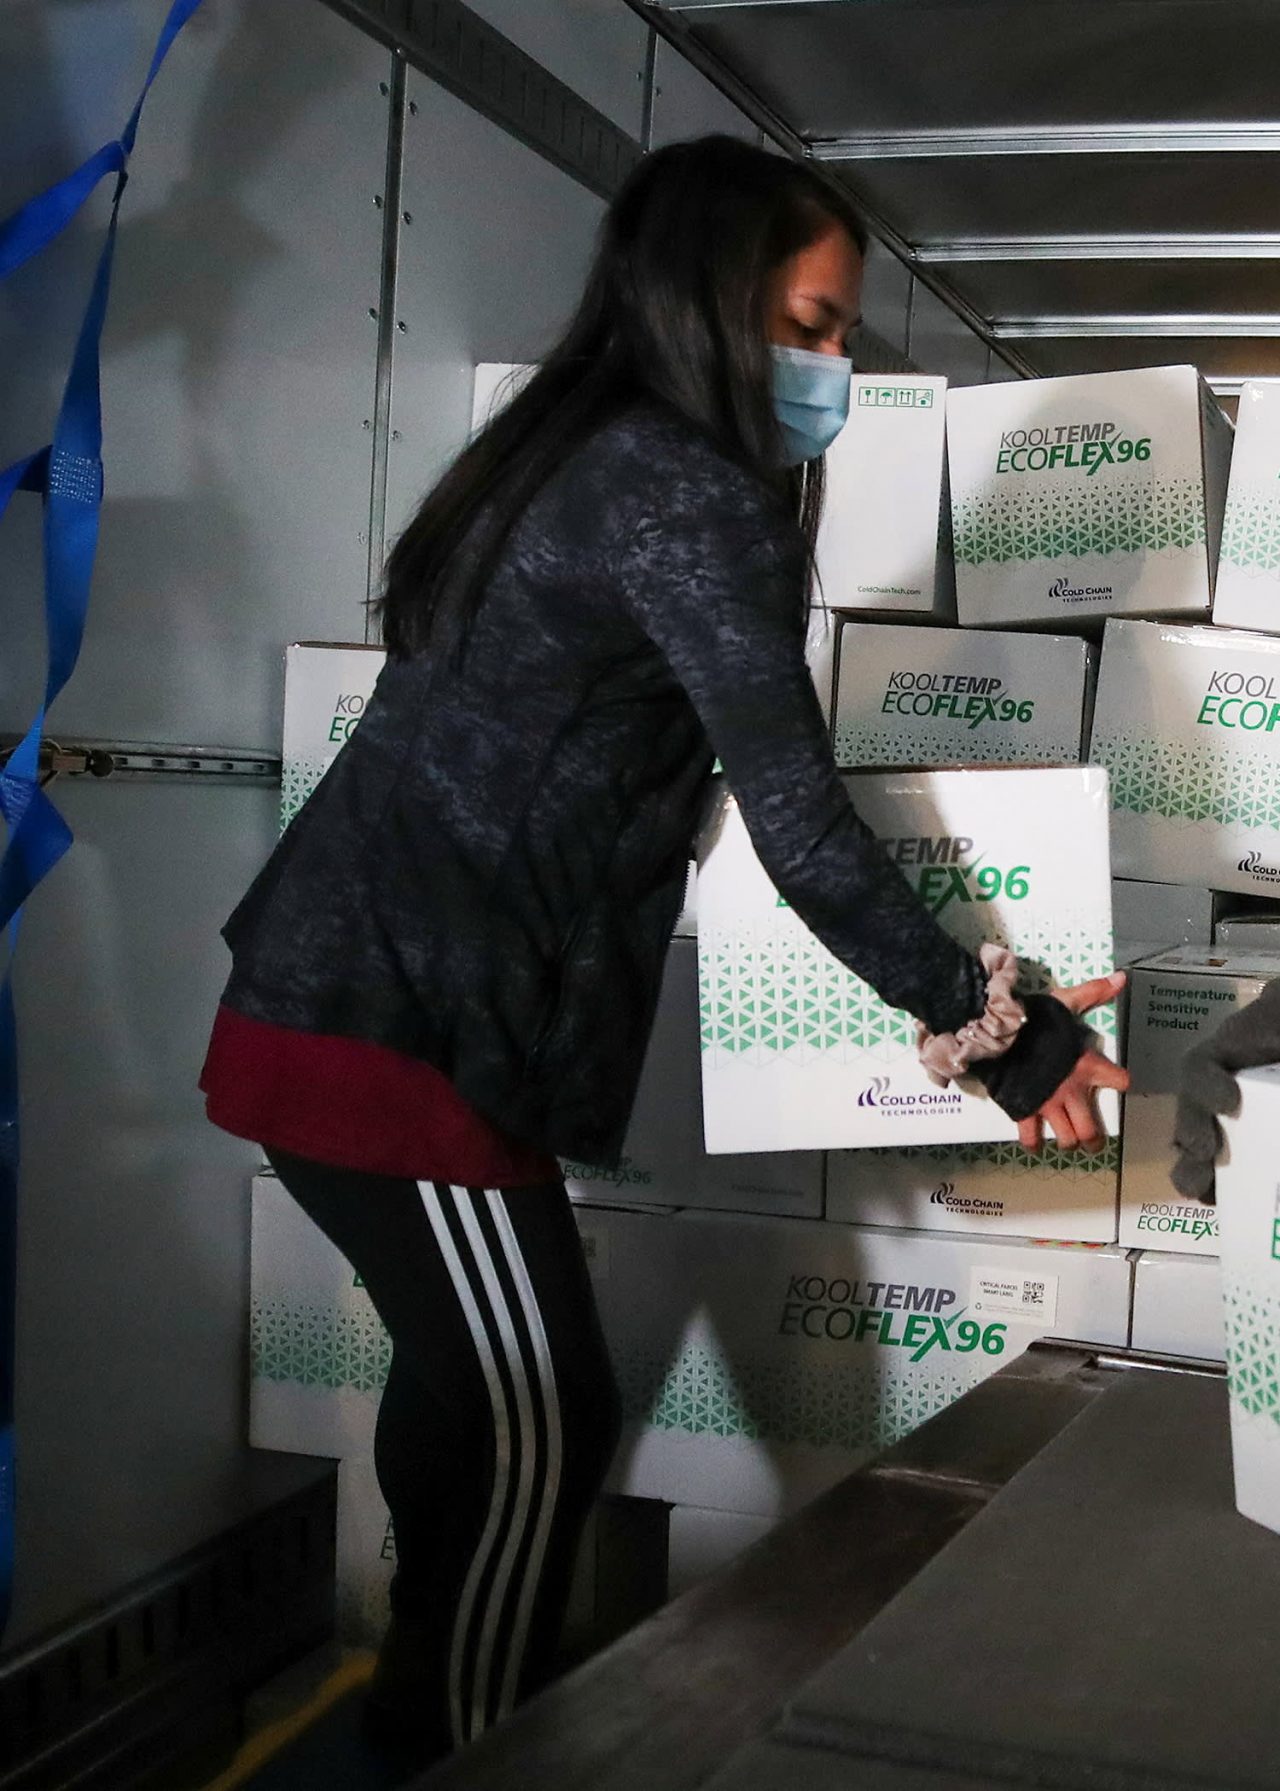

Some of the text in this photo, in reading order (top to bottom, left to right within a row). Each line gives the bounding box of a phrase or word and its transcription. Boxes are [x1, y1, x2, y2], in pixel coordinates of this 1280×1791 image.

[1000, 422, 1115, 449] KOOLTEMP
[996, 430, 1151, 476] ECOFLEX96
[1062, 587, 1083, 597] COLD
[887, 671, 1002, 694] KOOLTEMP
[881, 690, 1034, 729] ECOFLEX96
[1253, 865, 1277, 876] COLD
[1149, 984, 1236, 1003] Temperature
[1148, 1002, 1209, 1016] Sensitive
[1147, 1016, 1199, 1031] Product
[880, 1093, 962, 1106] COLD CHAIN
[881, 1107, 963, 1117] TECHNOLOGIES
[946, 1196, 1004, 1210] COLD CHAIN
[1141, 1203, 1215, 1219] KOOLTEMP
[946, 1207, 1004, 1217] TECHNOLOGIES
[1137, 1215, 1220, 1241] ECOFLEX
[786, 1274, 956, 1313] KOOLTEMP
[778, 1303, 1008, 1362] ECOFLEX96
